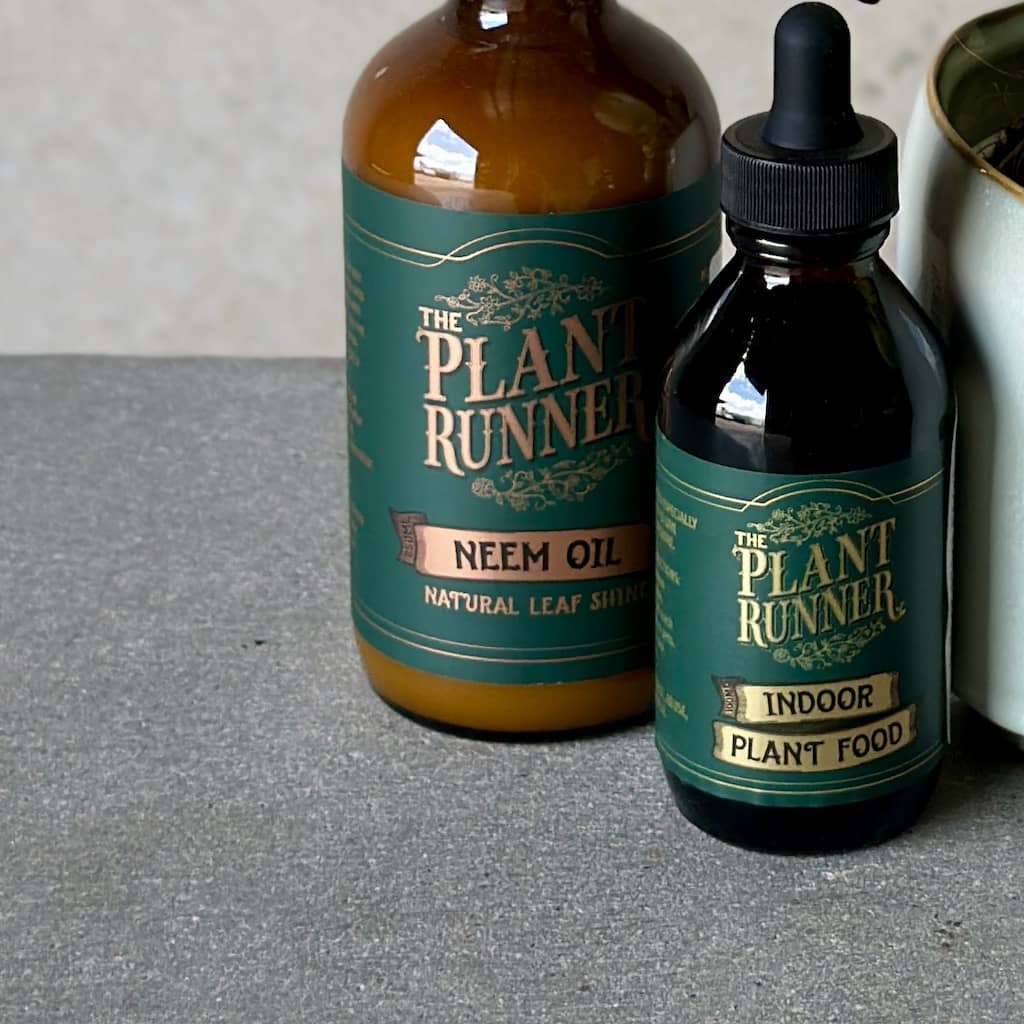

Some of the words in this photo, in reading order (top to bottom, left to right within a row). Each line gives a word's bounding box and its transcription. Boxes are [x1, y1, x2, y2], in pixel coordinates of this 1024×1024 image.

[418, 306, 463, 333] THE
[416, 296, 647, 403] PLANT
[423, 370, 651, 476] RUNNER
[454, 540, 550, 572] NEEM
[566, 536, 622, 570] OIL
[732, 517, 896, 597] PLANT
[734, 531, 768, 549] THE
[424, 584, 520, 616] NATURAL
[529, 593, 583, 616] LEAF
[737, 570, 906, 648] RUNNER
[763, 684, 874, 716] INDOOR
[731, 733, 824, 766] PLANT
[838, 721, 903, 762] FOOD
